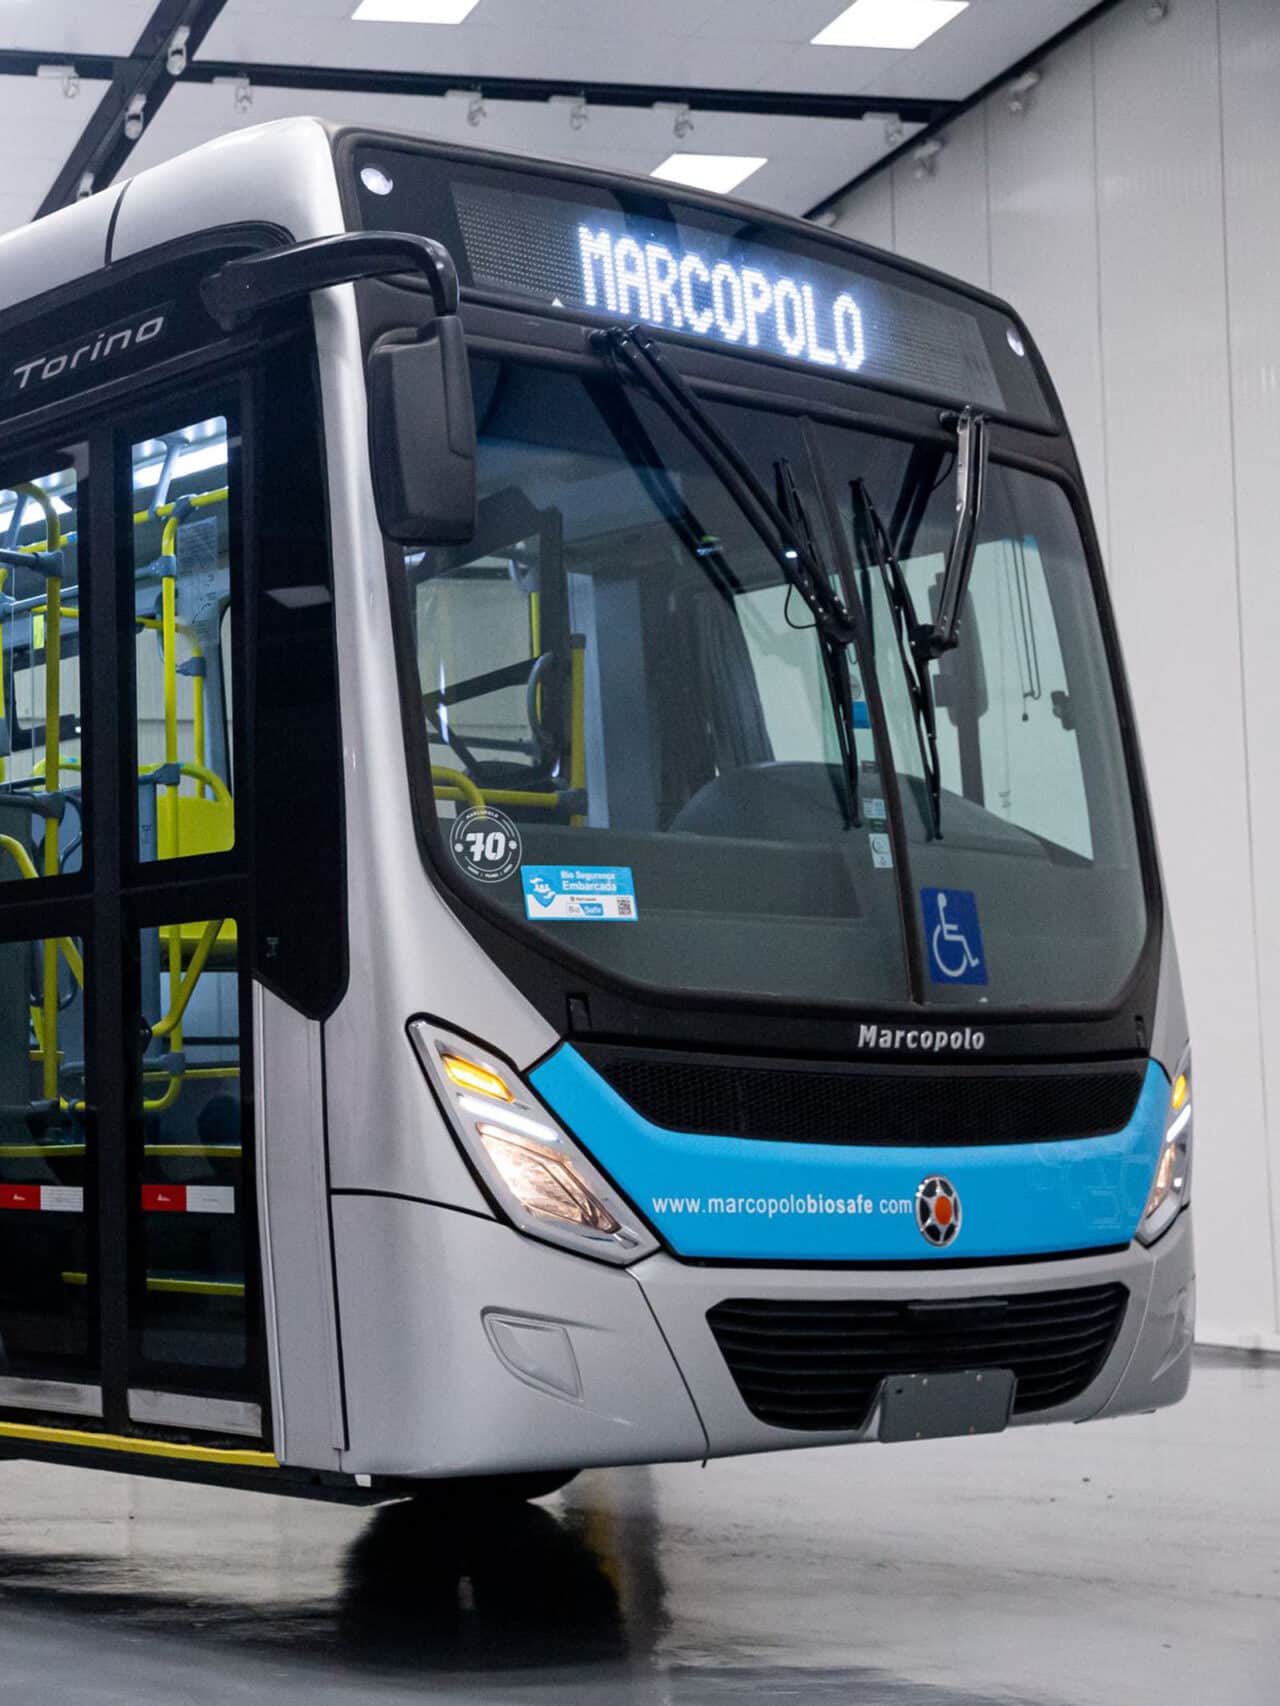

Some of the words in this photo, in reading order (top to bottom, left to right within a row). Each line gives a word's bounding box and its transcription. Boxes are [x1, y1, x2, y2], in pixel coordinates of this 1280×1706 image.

[578, 223, 865, 371] MARCOPOLO
[13, 316, 164, 389] Torino
[465, 831, 506, 862] 70
[858, 1024, 986, 1052] Marcopolo
